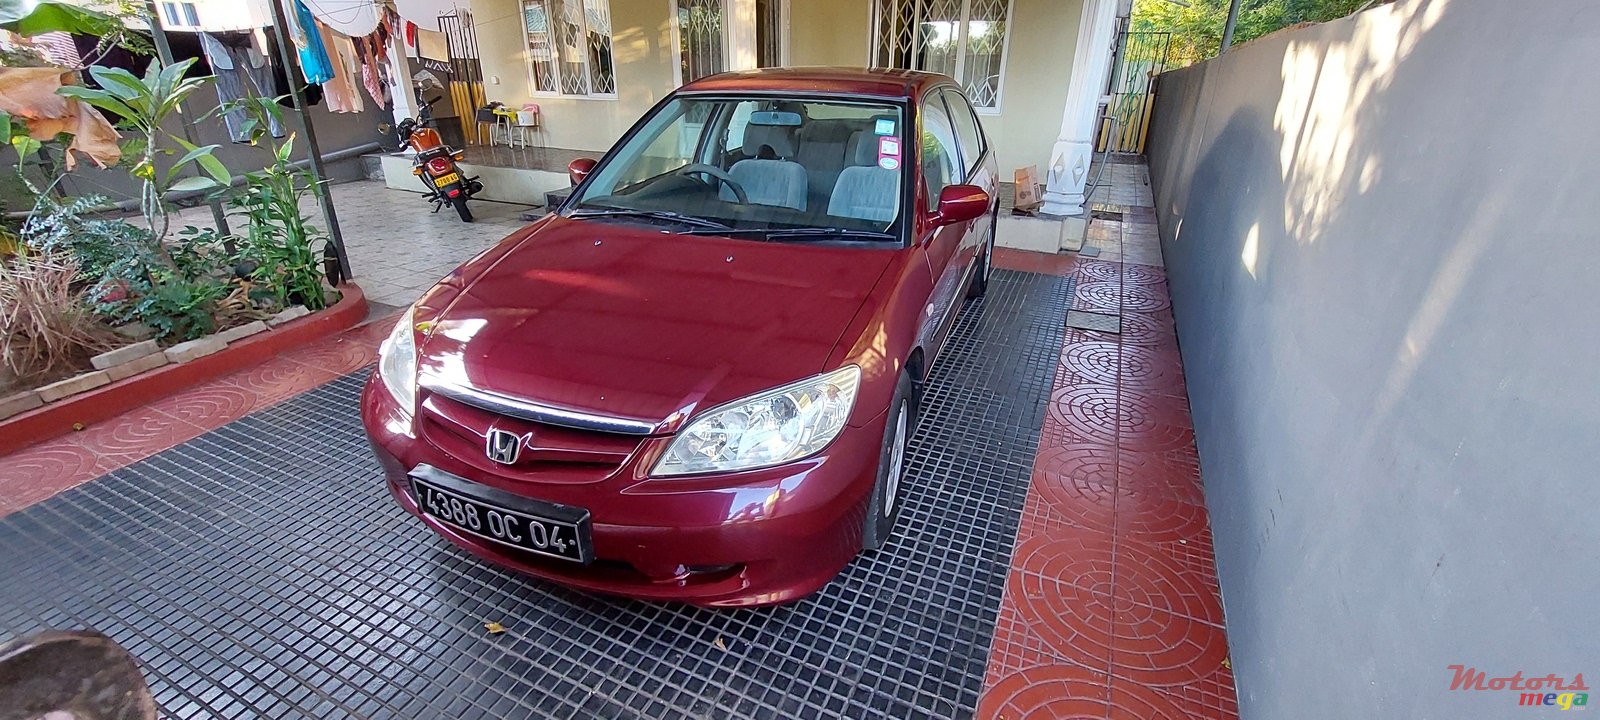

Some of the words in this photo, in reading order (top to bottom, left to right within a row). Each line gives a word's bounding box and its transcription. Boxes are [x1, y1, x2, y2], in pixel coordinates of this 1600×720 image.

[426, 488, 482, 531] 4388
[487, 510, 522, 542] OC
[529, 520, 567, 554] 04
